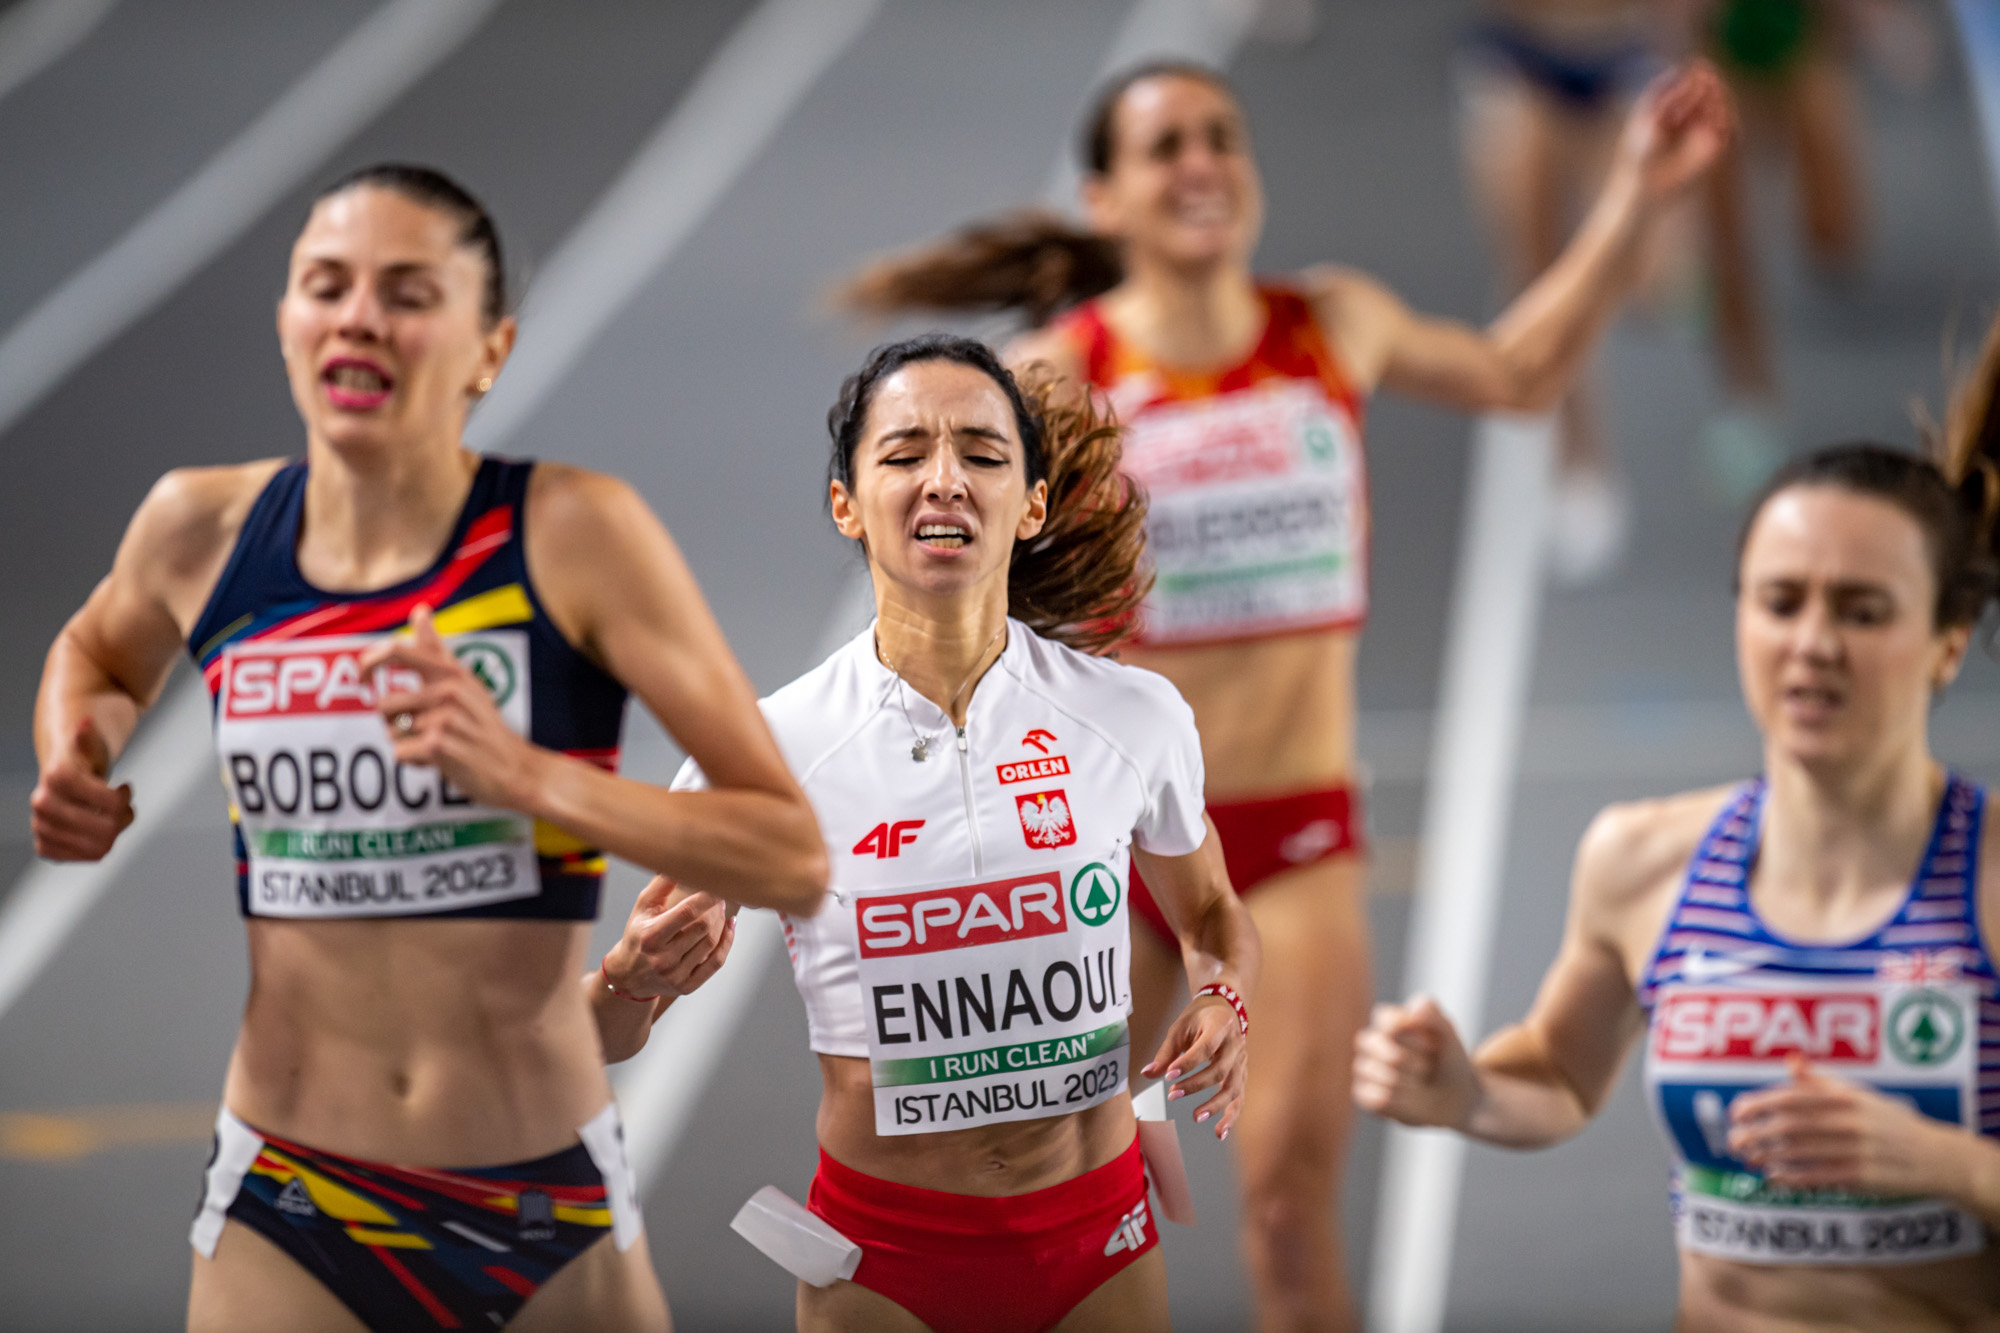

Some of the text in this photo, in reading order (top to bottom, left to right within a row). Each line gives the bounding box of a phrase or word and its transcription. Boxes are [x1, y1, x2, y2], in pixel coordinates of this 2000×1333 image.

[1000, 757, 1067, 783] ORLEN
[852, 819, 926, 859] 4F
[261, 852, 515, 906] STANBUL 2023
[862, 882, 1061, 949] SPAR
[872, 947, 1116, 1046] ENNAOUI
[1667, 1000, 1873, 1056] SPAR
[895, 1060, 1119, 1125] ISTANBUL 2023
[930, 1059, 938, 1080] I
[945, 1050, 999, 1078] RUN
[1104, 1199, 1148, 1257] 4F
[1694, 1209, 1851, 1250] STANBUL
